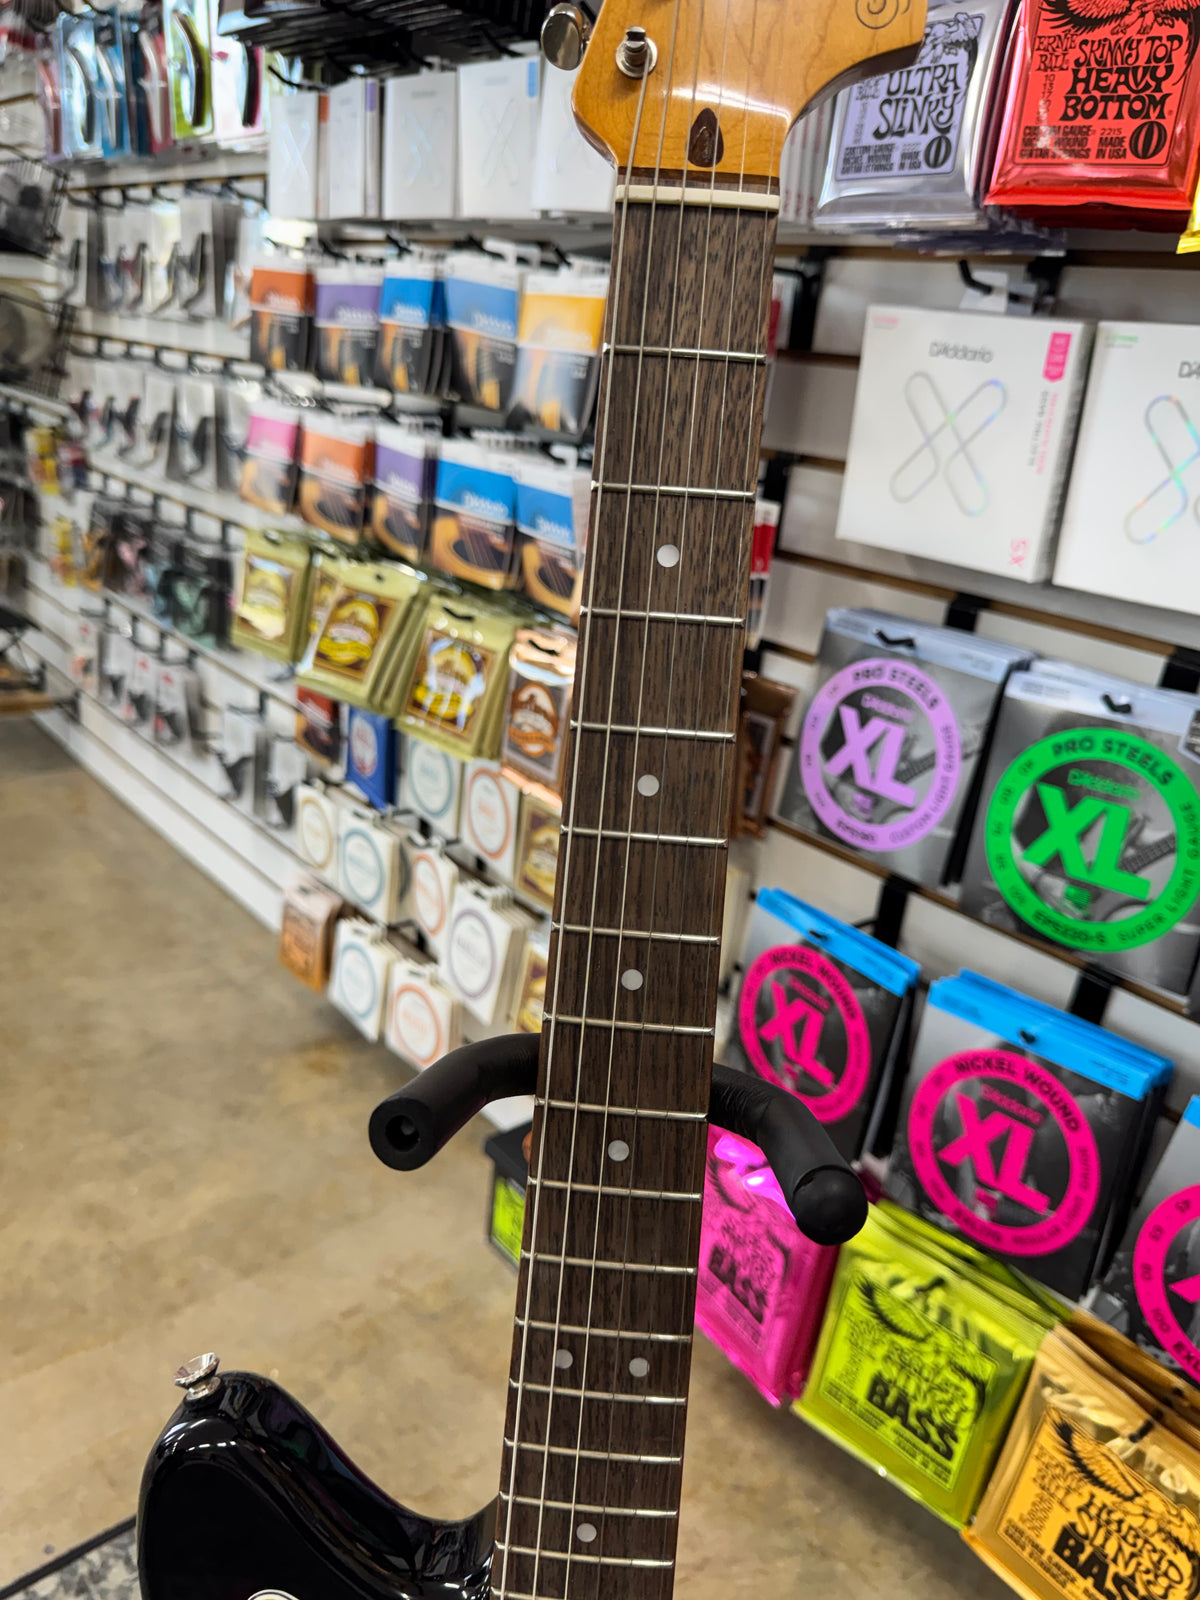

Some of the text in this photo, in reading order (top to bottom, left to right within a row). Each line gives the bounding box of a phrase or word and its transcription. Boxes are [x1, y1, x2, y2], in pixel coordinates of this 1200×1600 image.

[1036, 34, 1078, 52] ERNIE
[1036, 52, 1069, 72] BALL
[1074, 35, 1184, 68] SKINNY TOP
[887, 63, 961, 96] ULTRA
[1066, 64, 1174, 94] HEAVY
[872, 91, 961, 141] SLINKY
[1059, 93, 1173, 121] BOTTOM
[1096, 149, 1127, 160] IN USA
[1099, 136, 1126, 148] MADE
[853, 667, 938, 711] PRO STEELS
[824, 703, 917, 807] XL
[1052, 736, 1175, 787] PRO STEELS
[1021, 781, 1151, 901] XL
[1165, 868, 1197, 914] LIGHT
[758, 977, 836, 1091] XL
[954, 1056, 1017, 1075] NICKEL
[1023, 1070, 1080, 1133] WOUND
[937, 1091, 1050, 1215] XL
[1152, 1308, 1171, 1333] 100
[866, 1370, 959, 1462] BASS
